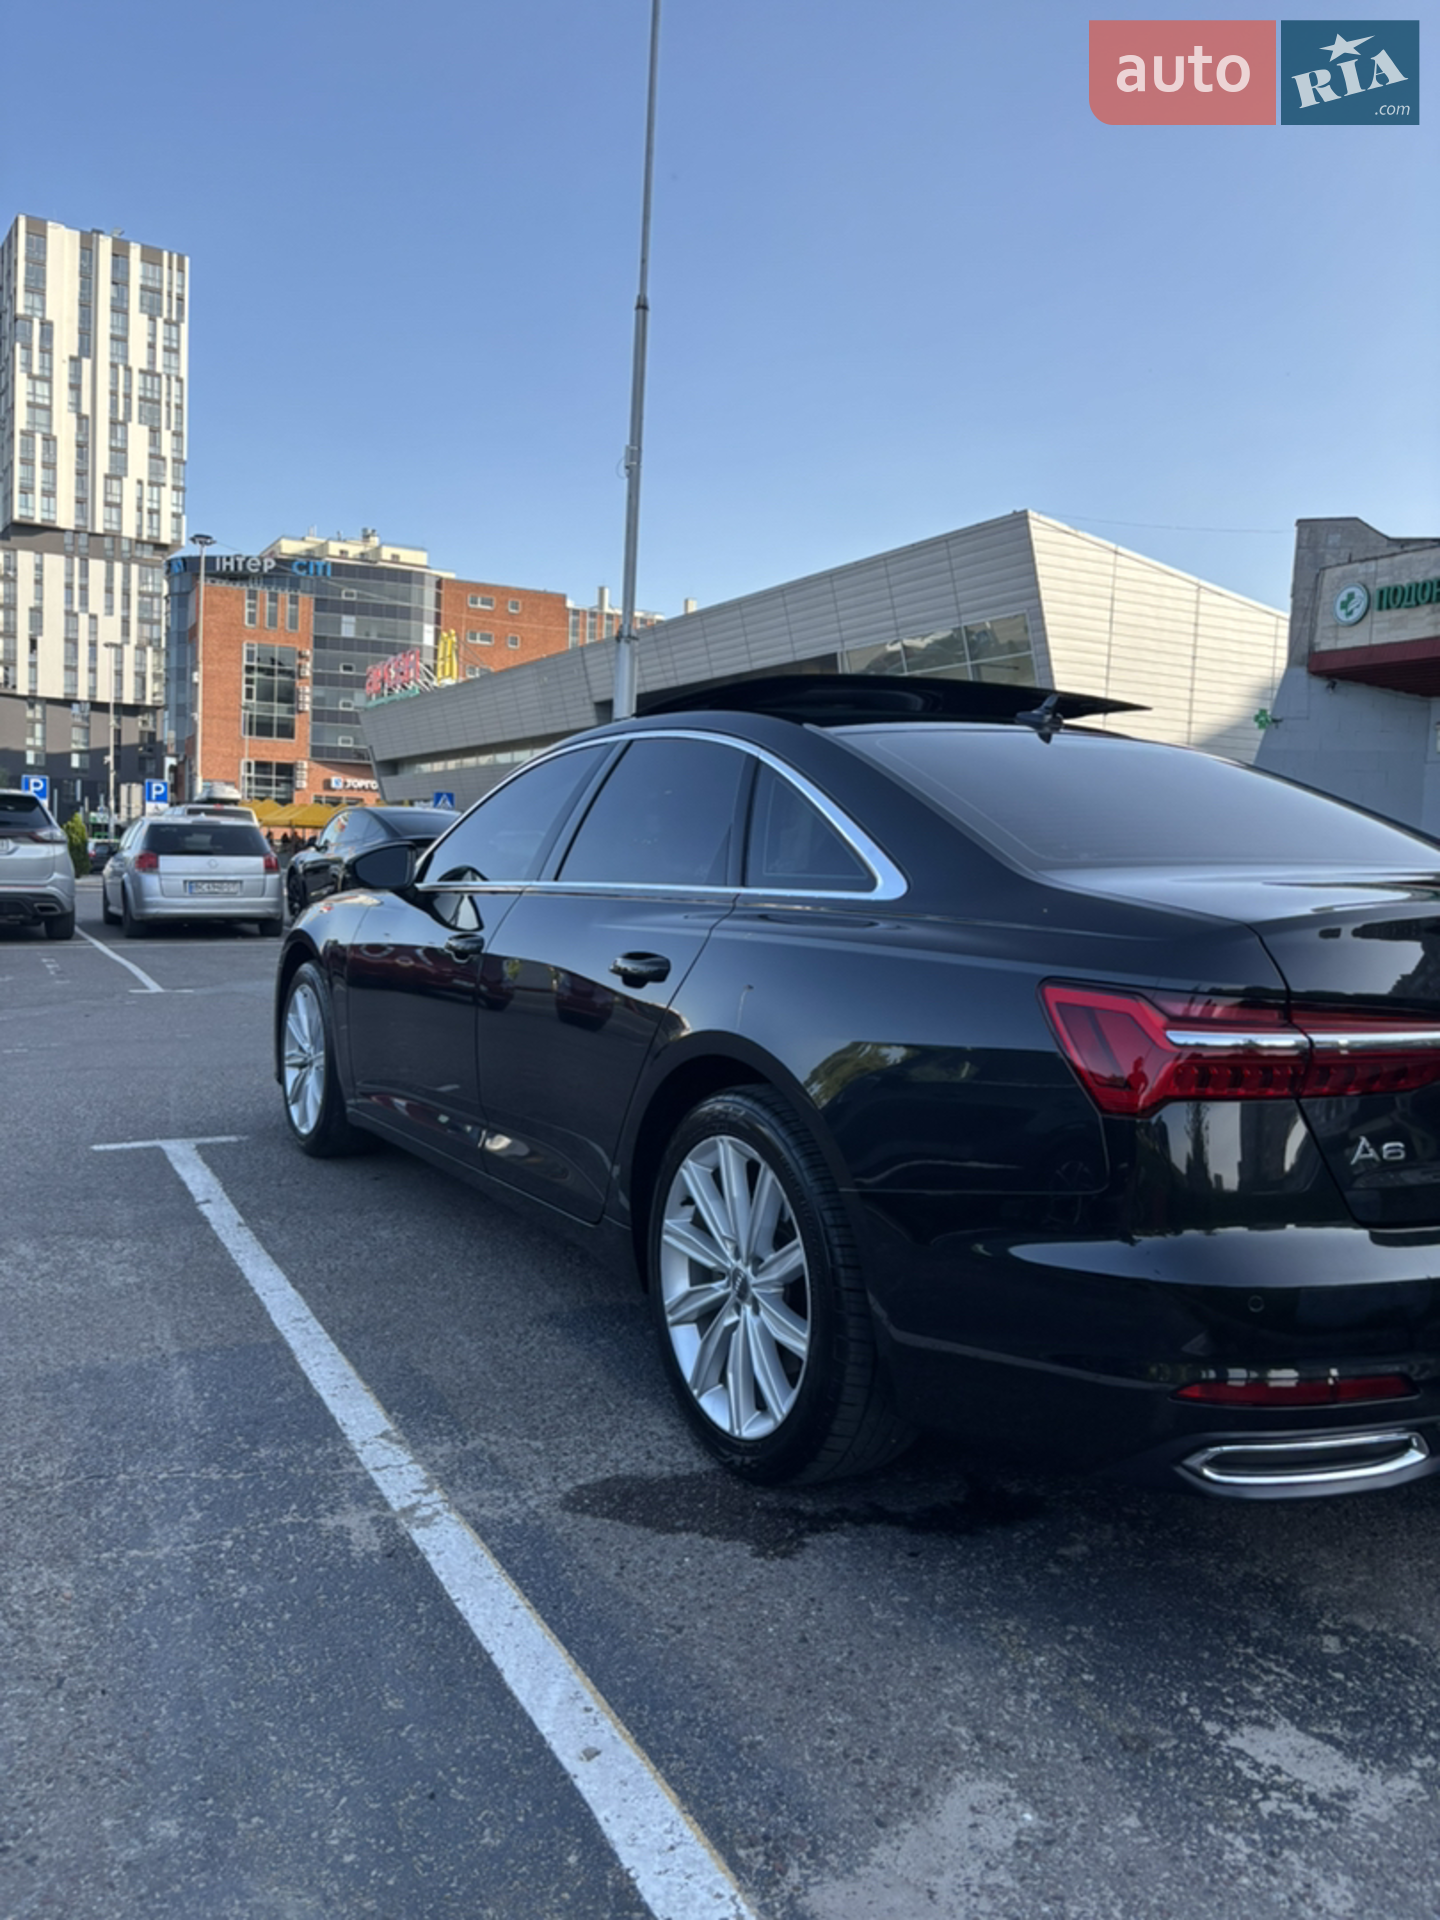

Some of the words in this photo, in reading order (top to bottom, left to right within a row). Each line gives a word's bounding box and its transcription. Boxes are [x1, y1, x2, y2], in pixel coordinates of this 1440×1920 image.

[29, 778, 44, 794] P
[151, 782, 166, 801] P
[1350, 1135, 1406, 1166] A6
